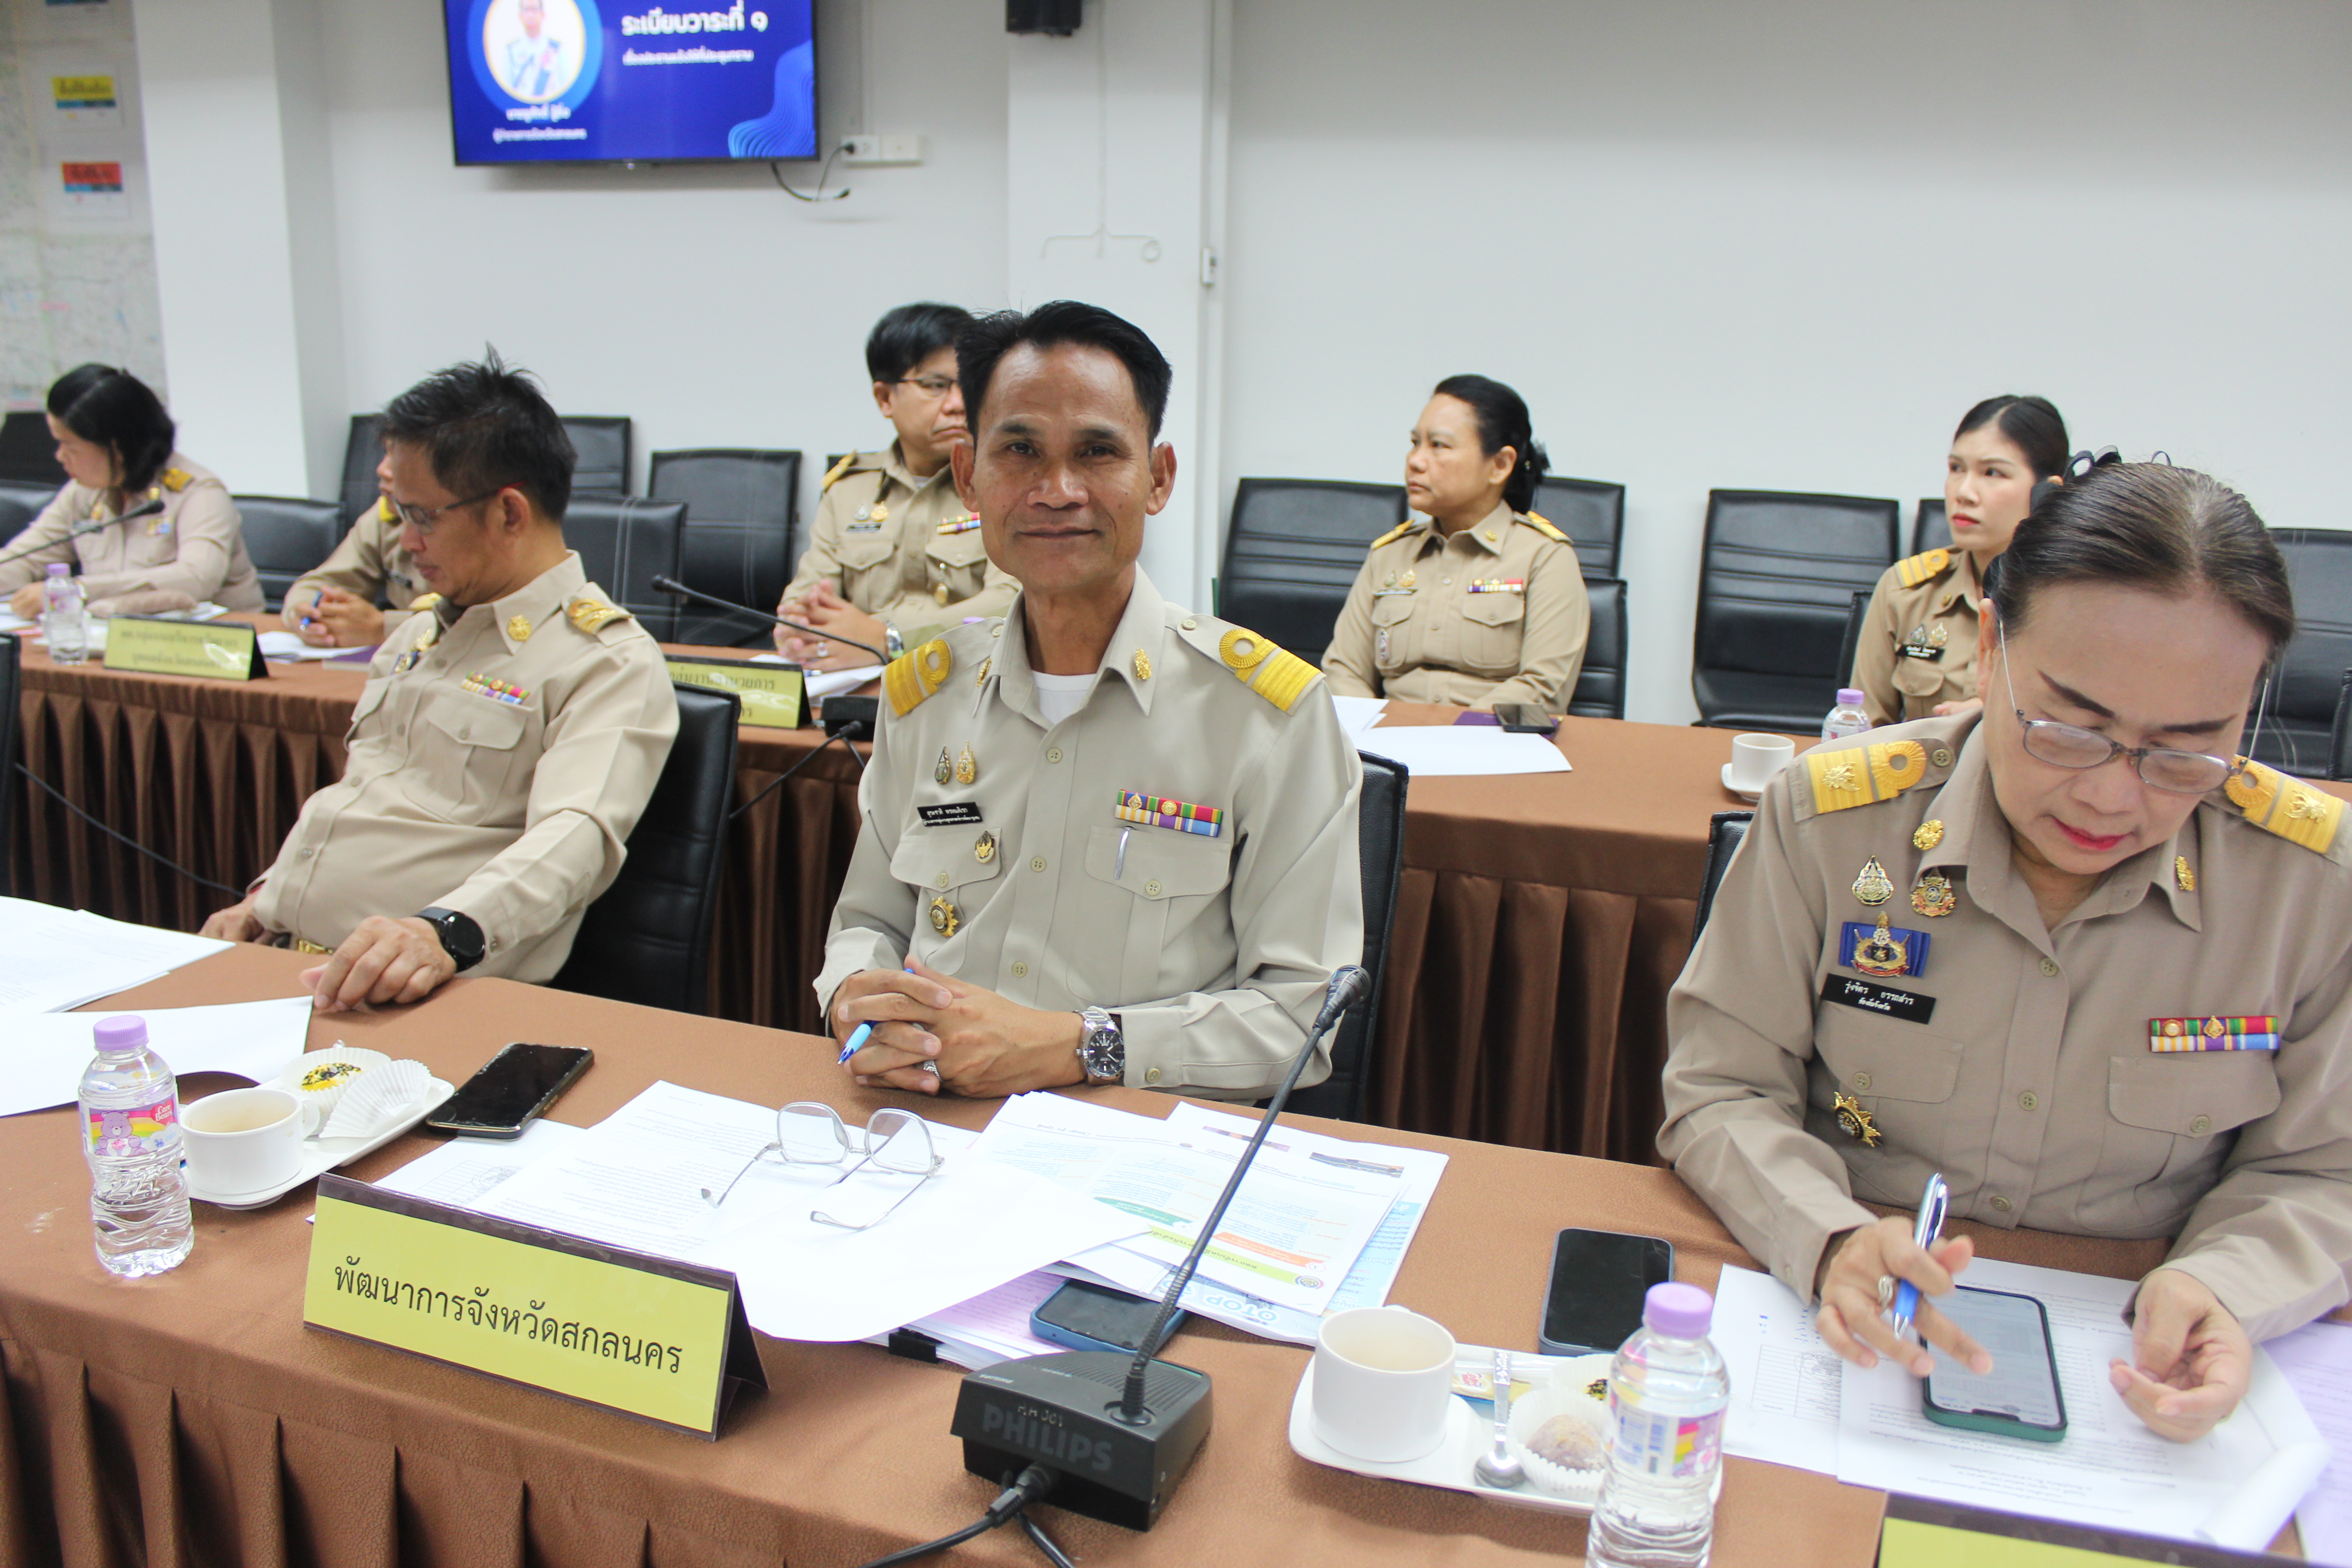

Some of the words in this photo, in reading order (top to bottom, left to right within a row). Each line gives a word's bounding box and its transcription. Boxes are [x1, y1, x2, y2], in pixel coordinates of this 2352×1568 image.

[622, 0, 745, 36] ระเบียบวาระที่
[155, 1109, 172, 1122] Bears
[158, 1104, 171, 1114] Care
[335, 1255, 683, 1373] พัฒนาการจังหวัดสกลนคร
[1206, 1296, 1277, 1321] OTOP
[982, 1402, 1112, 1471] PHILIPS
